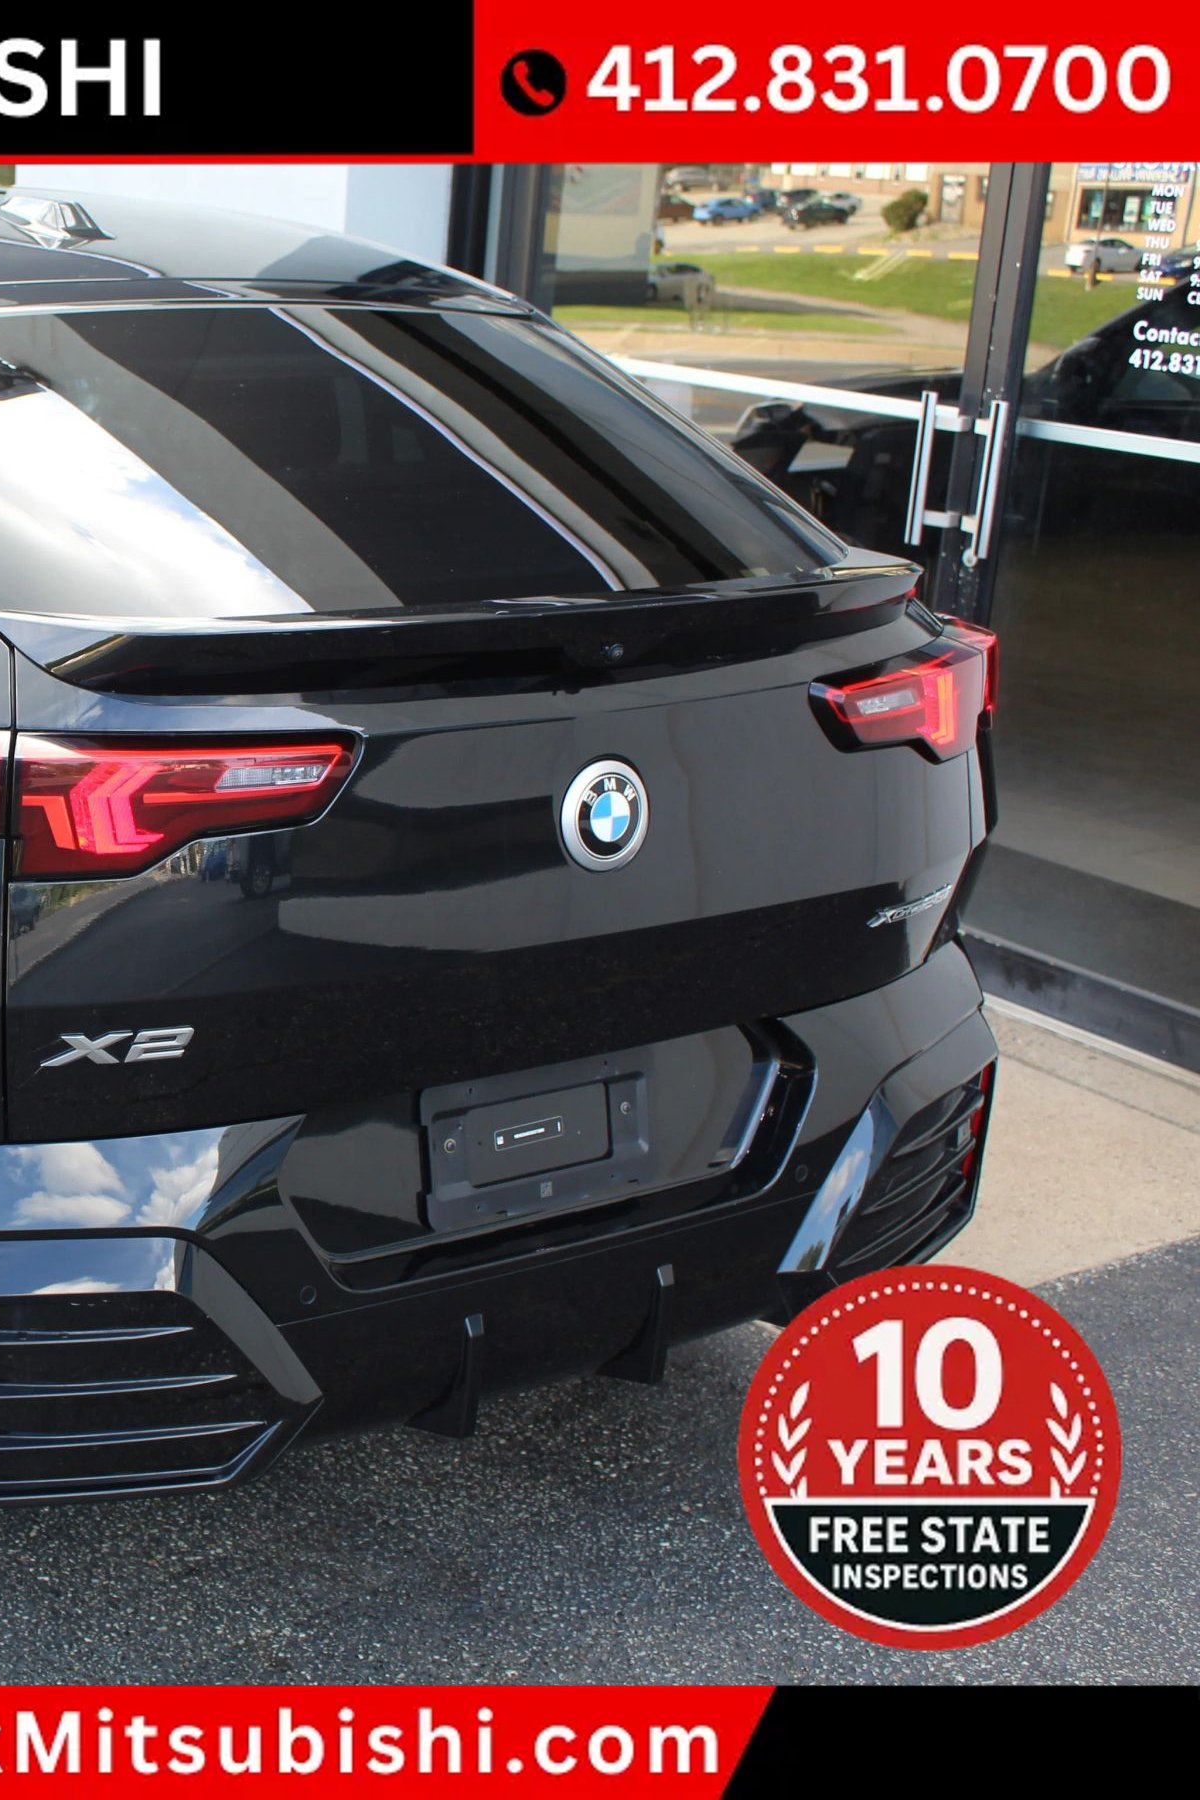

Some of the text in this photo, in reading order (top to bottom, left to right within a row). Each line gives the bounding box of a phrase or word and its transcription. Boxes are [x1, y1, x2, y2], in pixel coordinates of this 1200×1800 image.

[1152, 185, 1184, 197] MON
[1150, 201, 1173, 214] TUE
[1148, 219, 1176, 232] WED
[1145, 236, 1169, 249] THU
[1142, 253, 1162, 266] FRI
[1139, 269, 1163, 283] SAT
[1136, 286, 1164, 301] SUN
[1133, 320, 1200, 347] Contac
[583, 777, 636, 806] BMW
[40, 1026, 195, 1067] X2
